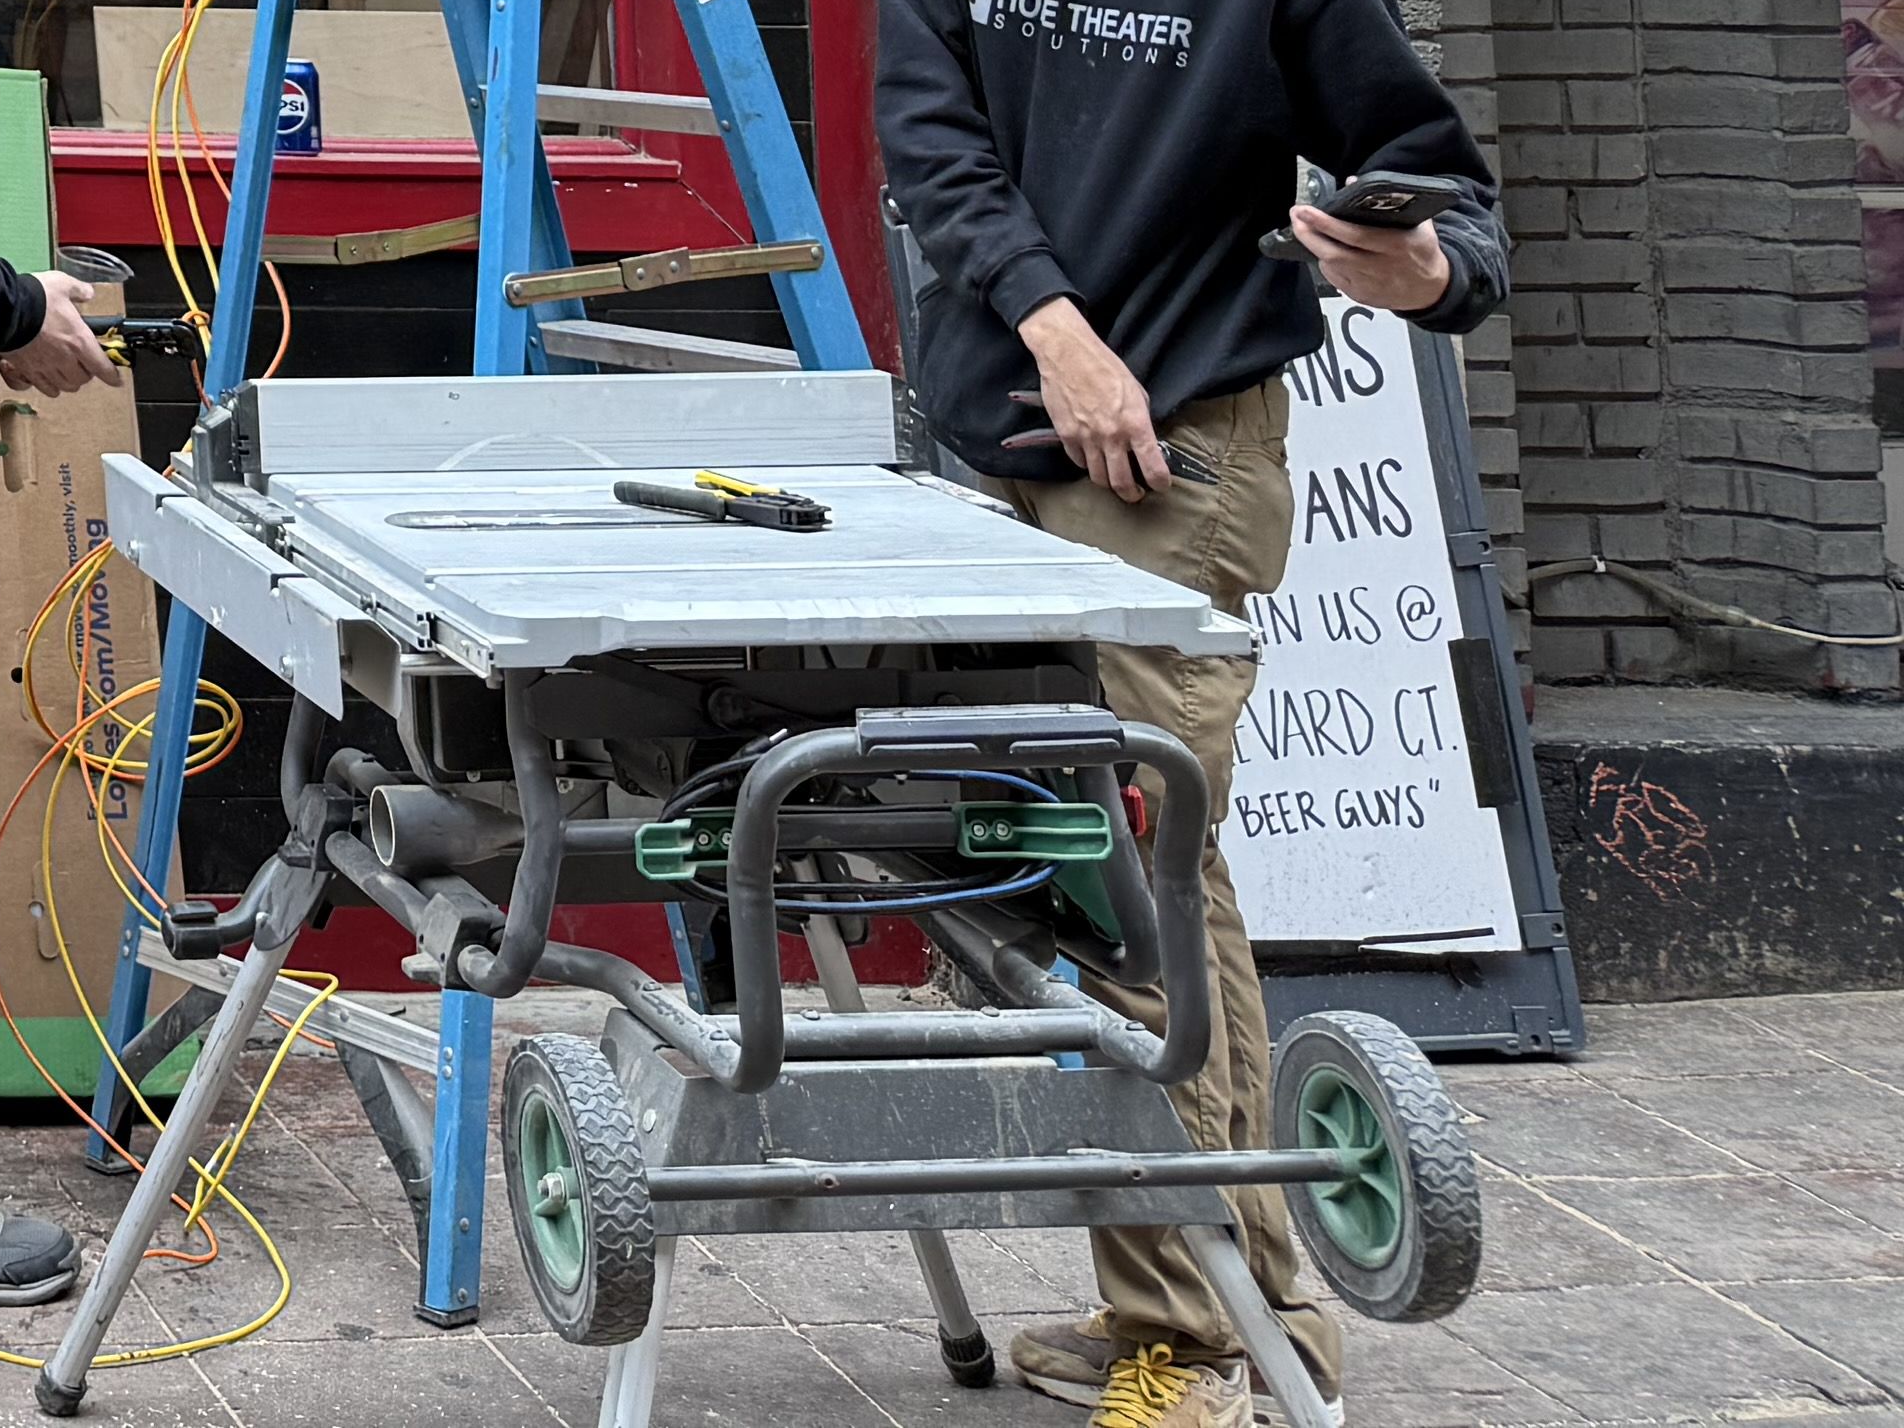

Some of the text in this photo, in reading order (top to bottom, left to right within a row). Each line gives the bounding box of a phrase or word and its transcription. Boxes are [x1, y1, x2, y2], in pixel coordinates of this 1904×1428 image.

[1067, 1, 1193, 48] THEATER
[57, 462, 72, 497] visit
[61, 500, 78, 568] moothly,
[1321, 585, 1382, 646] US
[1397, 584, 1443, 642] @
[1235, 790, 1327, 838] BEER
